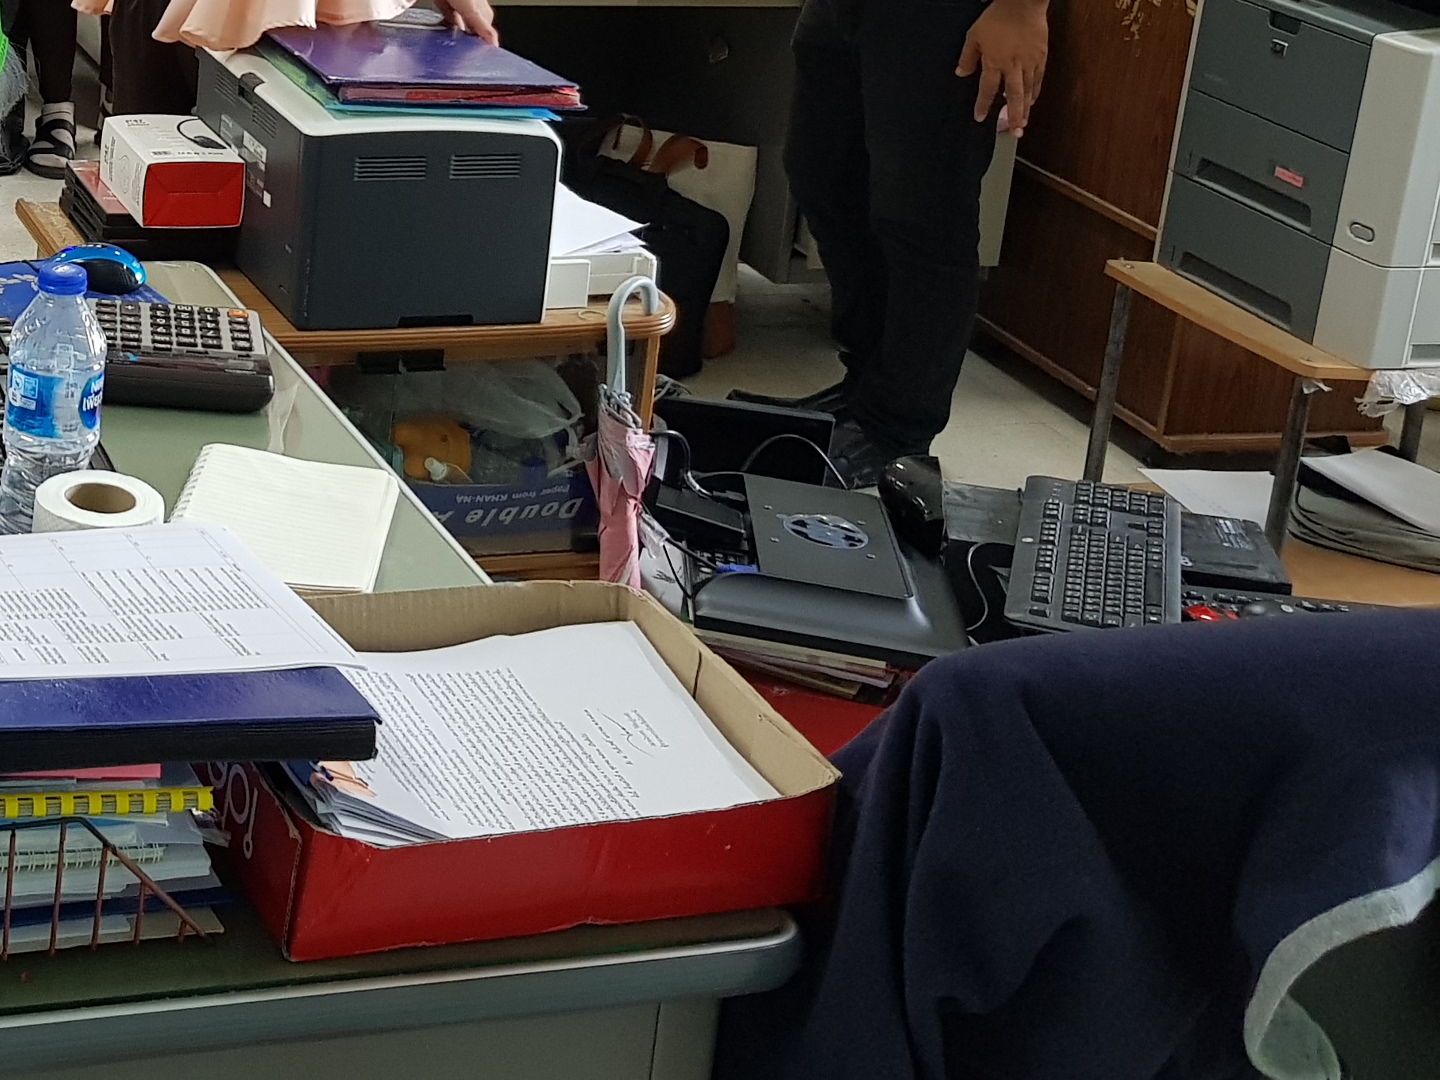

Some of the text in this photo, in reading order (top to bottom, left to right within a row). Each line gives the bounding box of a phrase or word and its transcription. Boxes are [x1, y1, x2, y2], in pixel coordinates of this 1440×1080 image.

[456, 493, 508, 504] KHAN-NA
[511, 490, 536, 499] from
[465, 497, 584, 527] Double
